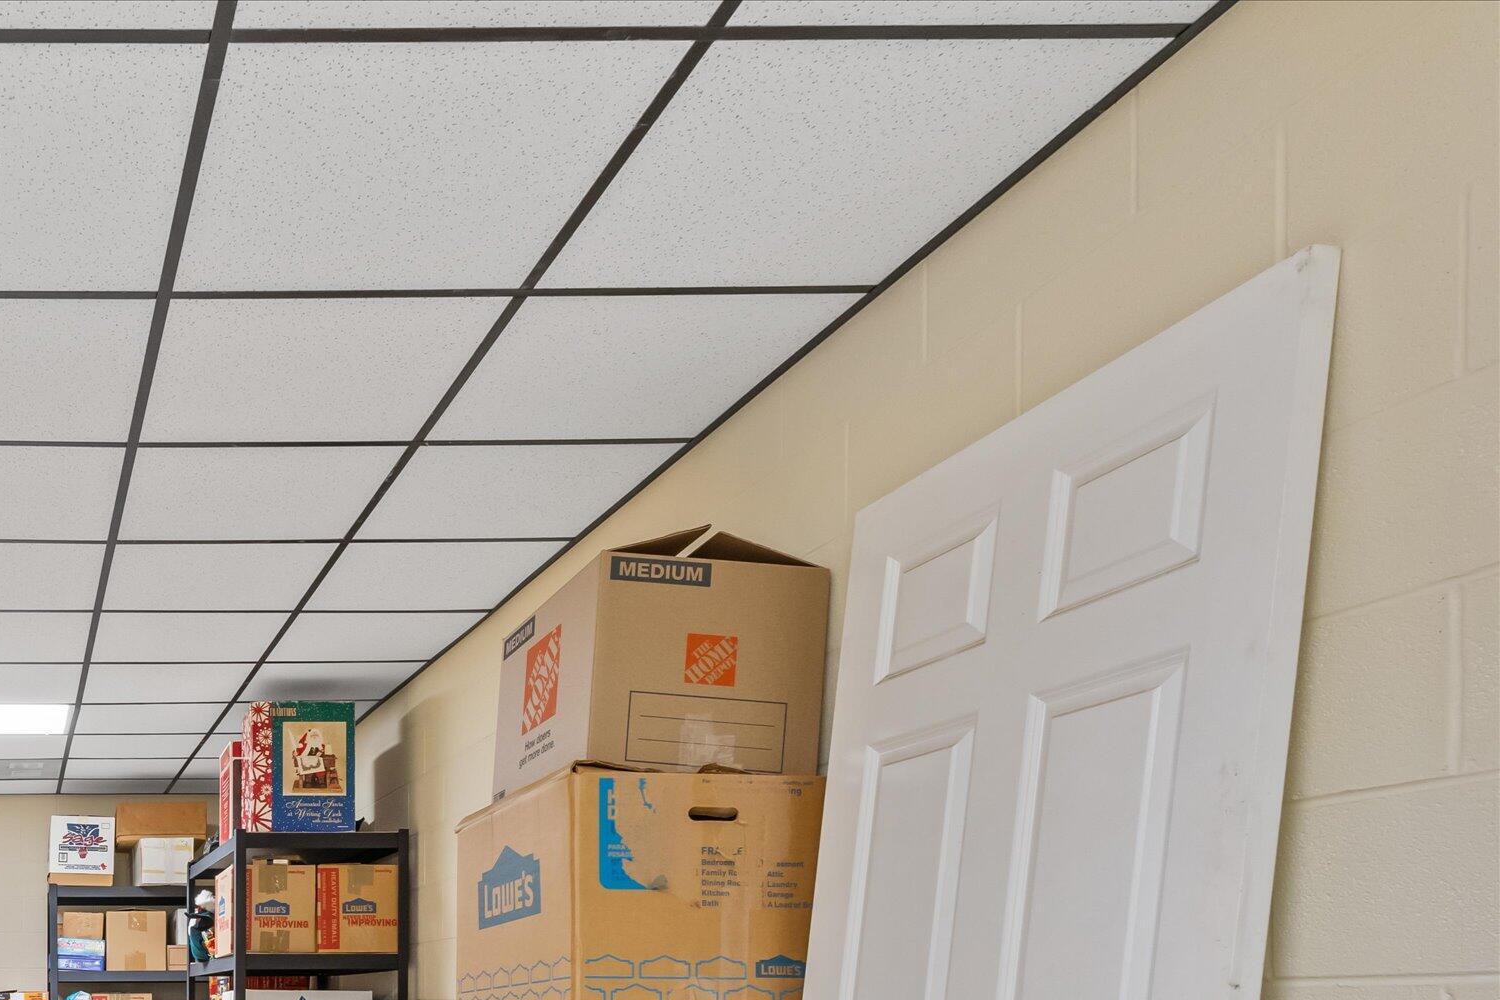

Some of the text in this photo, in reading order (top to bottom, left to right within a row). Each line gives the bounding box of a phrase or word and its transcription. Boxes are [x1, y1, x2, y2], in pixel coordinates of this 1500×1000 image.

[619, 561, 703, 582] MEDIUM
[505, 623, 533, 655] MEDIUM
[685, 636, 738, 685] HOME
[705, 657, 737, 685] DEPOT
[484, 870, 534, 919] LOWE'S
[701, 889, 730, 897] Kitchen
[259, 905, 286, 913] LOWE'S
[345, 904, 373, 912] LOWE'S
[259, 920, 308, 929] IMPROVING
[347, 918, 397, 927] IMPROVING
[761, 964, 801, 975] LOWE'S
